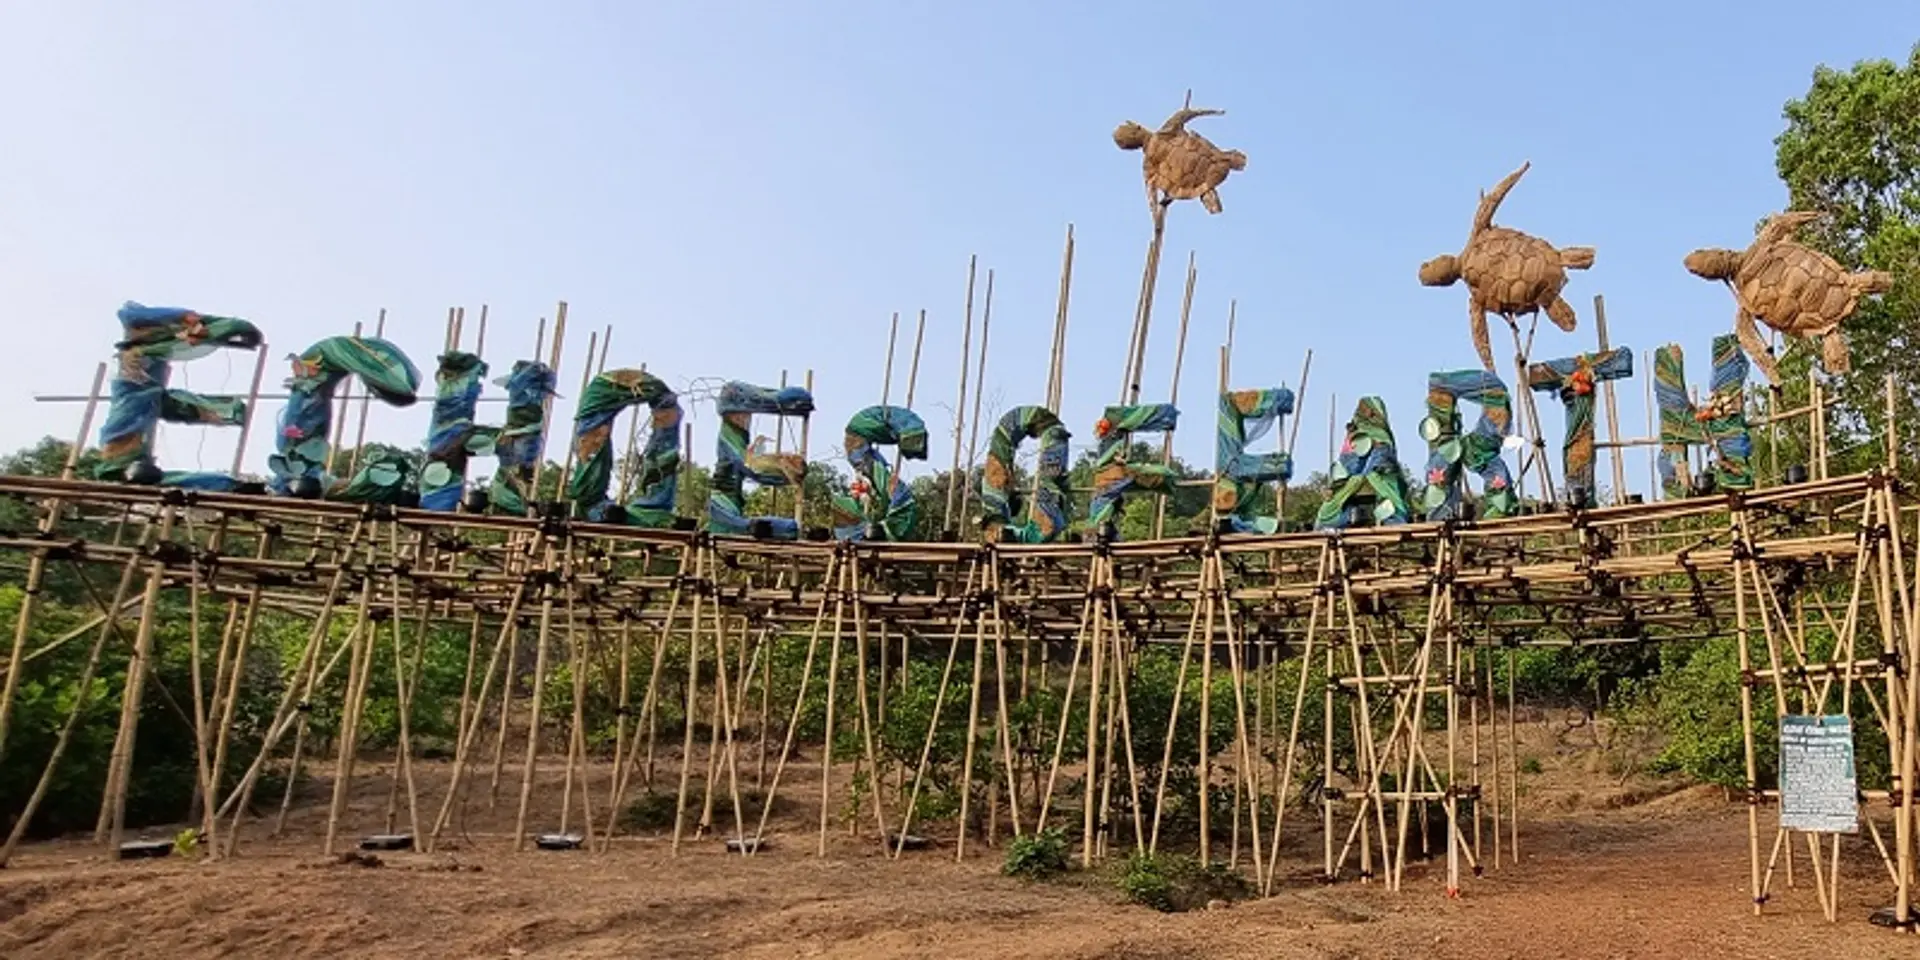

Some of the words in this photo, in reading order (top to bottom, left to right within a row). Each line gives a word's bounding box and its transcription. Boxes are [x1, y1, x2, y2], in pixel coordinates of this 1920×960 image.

[93, 301, 929, 541] ECHOES
[983, 404, 1180, 543] OF
[1217, 336, 1752, 534] EARTH
